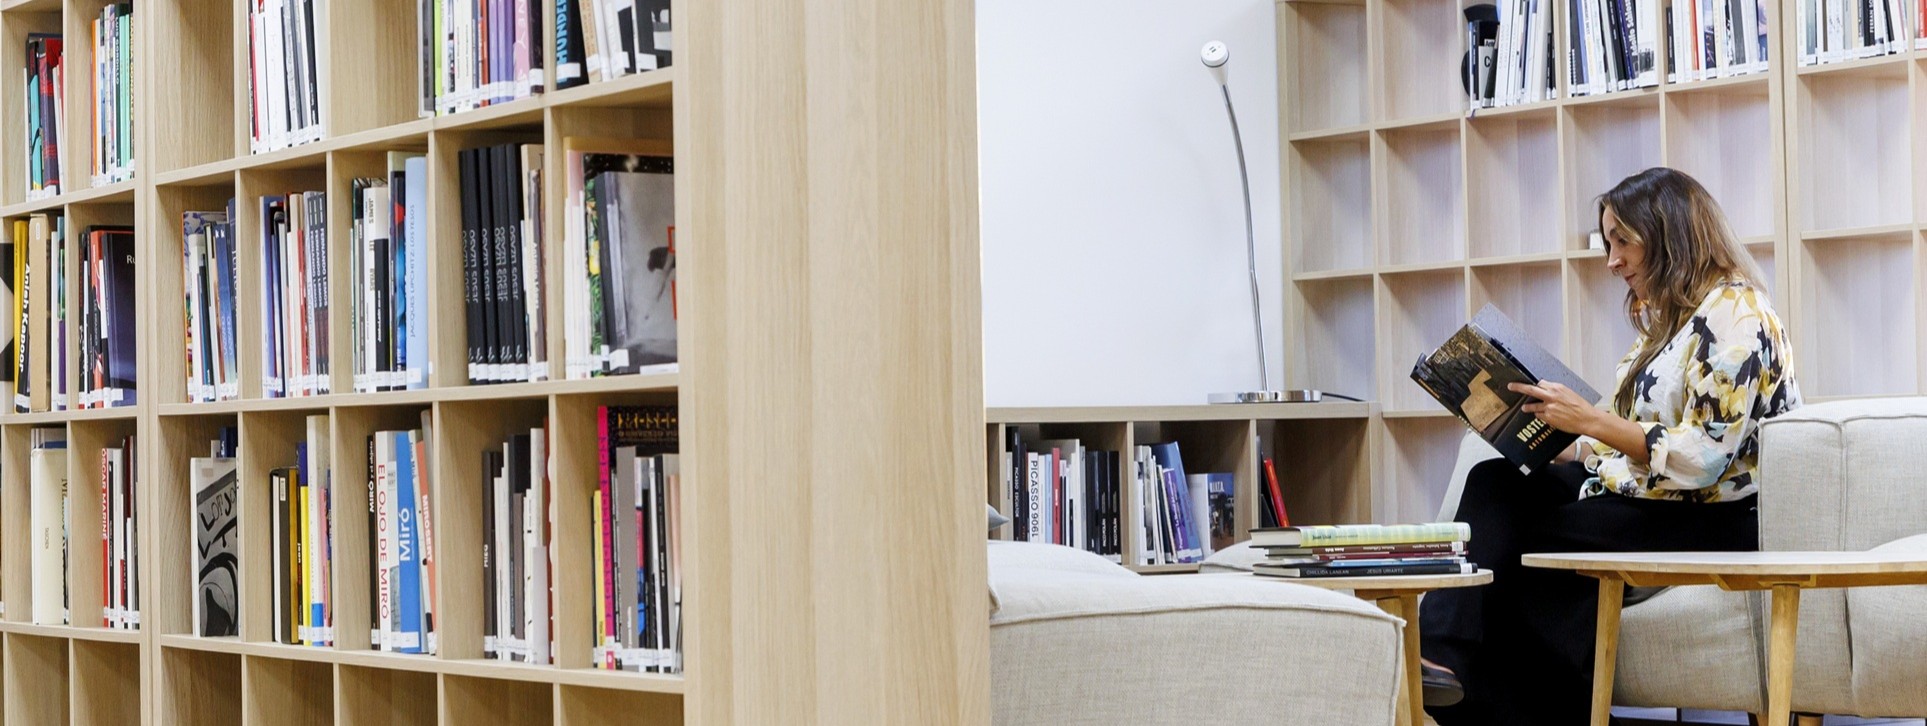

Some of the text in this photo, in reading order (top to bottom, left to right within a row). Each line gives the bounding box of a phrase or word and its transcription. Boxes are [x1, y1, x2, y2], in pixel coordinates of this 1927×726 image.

[19, 263, 31, 373] Anish Kapoor
[367, 480, 375, 513] MIRÓ
[1031, 460, 1039, 511] PICASSO
[378, 464, 389, 619] EL OJO DE MIRÓ
[398, 507, 411, 561] Miró
